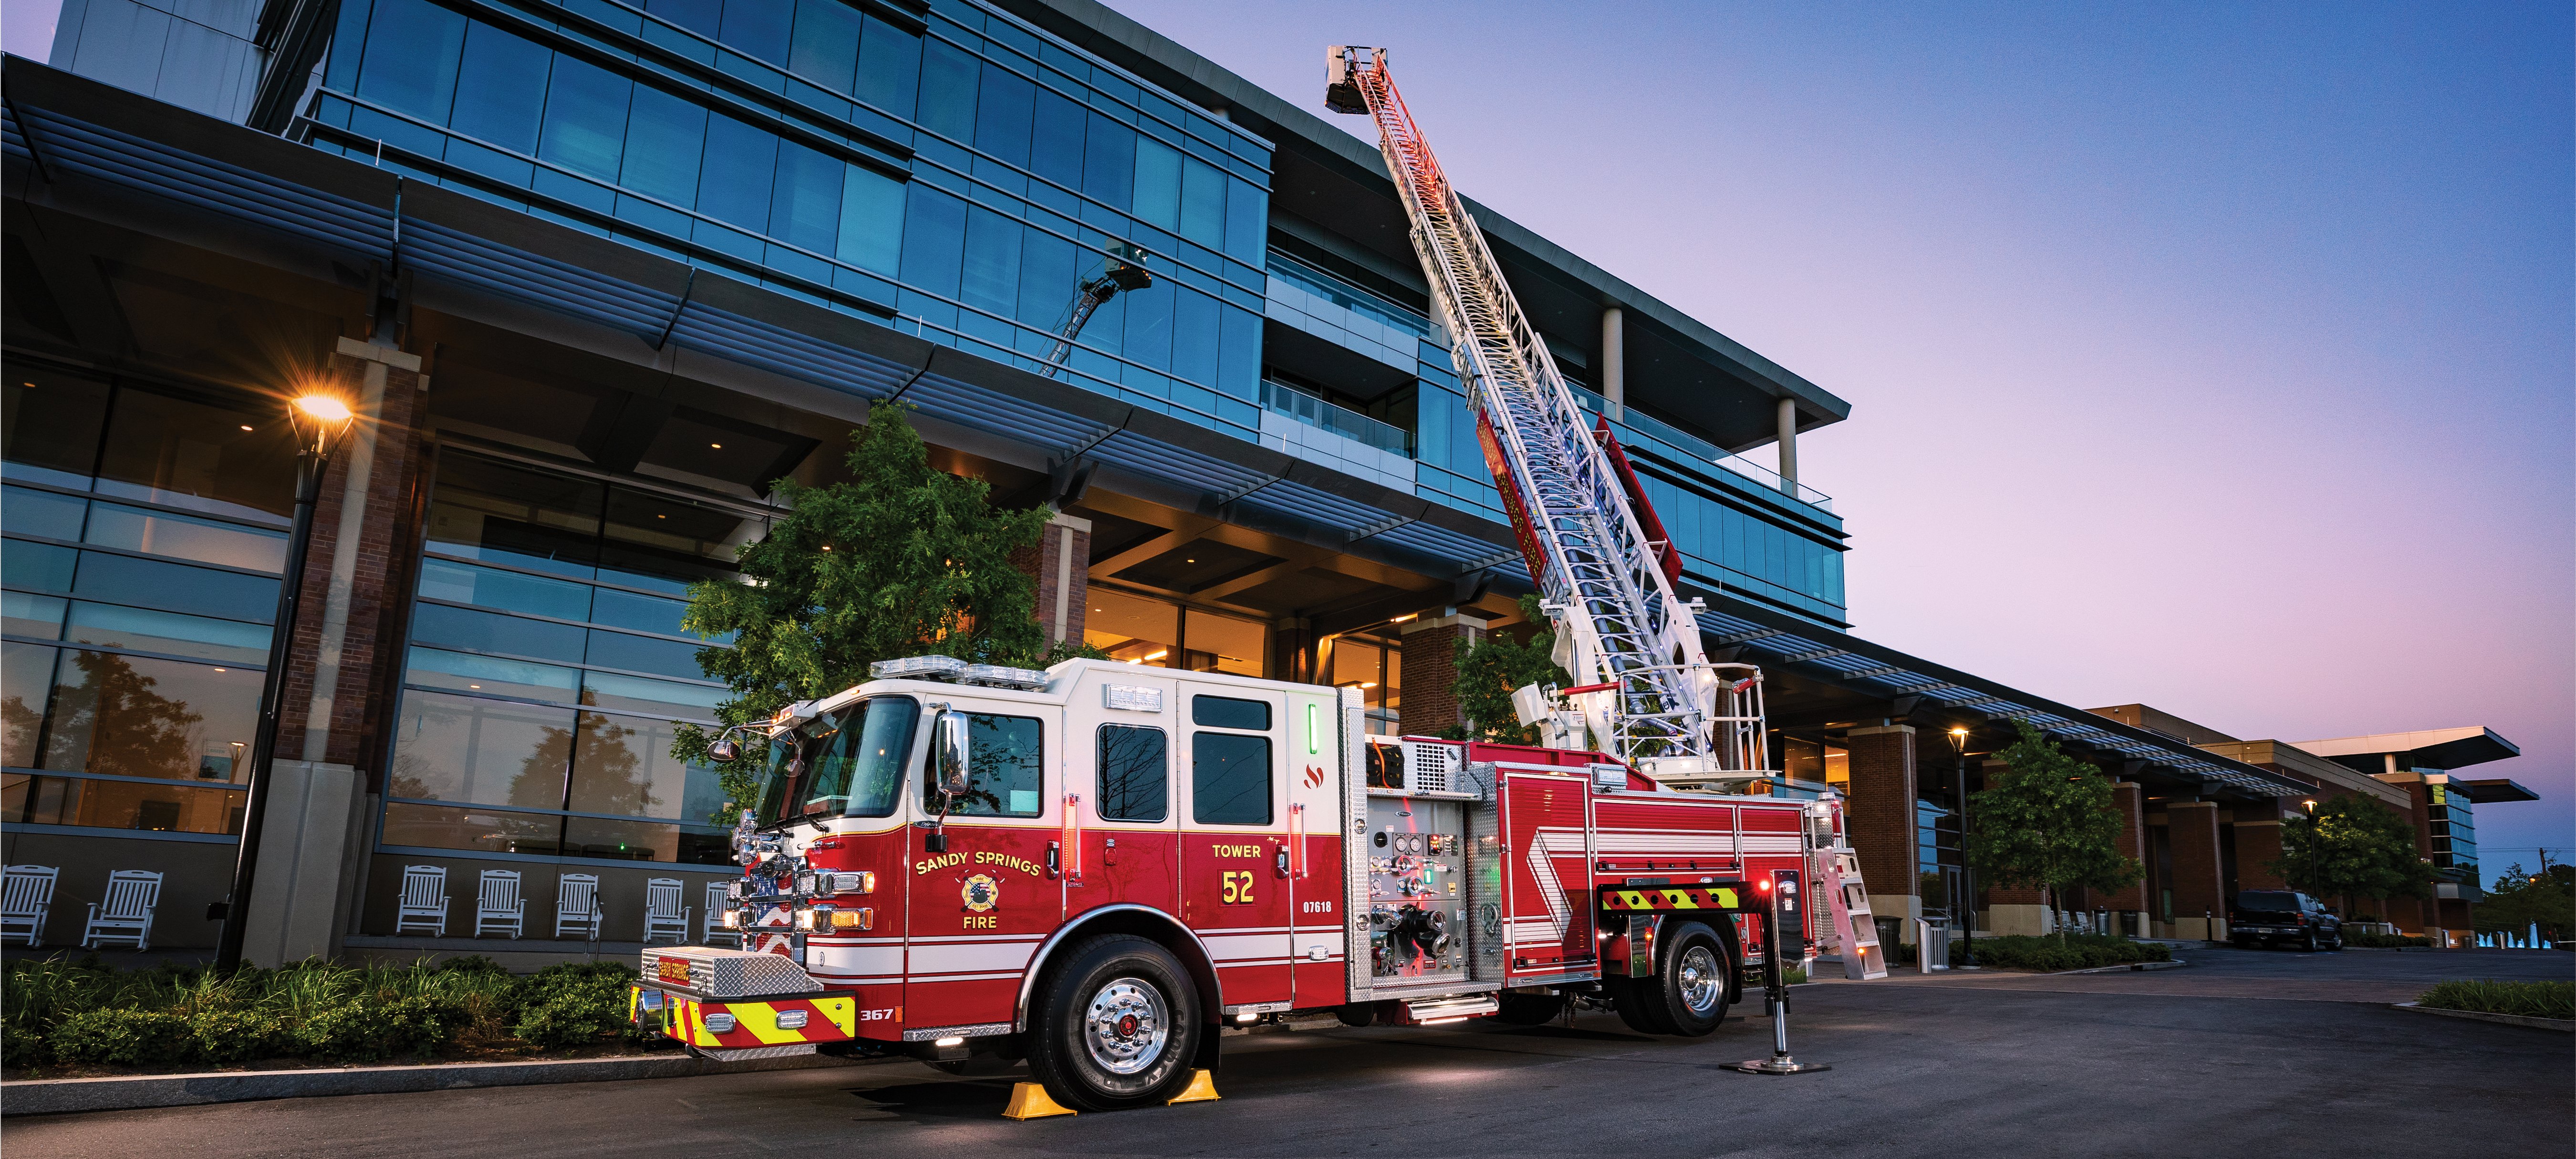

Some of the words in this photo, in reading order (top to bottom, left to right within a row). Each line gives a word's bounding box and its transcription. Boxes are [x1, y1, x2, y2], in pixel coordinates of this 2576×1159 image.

[1479, 419, 1497, 467] SANDY
[1496, 464, 1524, 533] SPRINGS
[1523, 532, 1540, 577] FIRE
[1212, 845, 1261, 858] TOWER
[915, 851, 968, 875] SANDY
[975, 851, 1041, 876] SPRINGS
[1222, 870, 1254, 904] 52
[1303, 901, 1331, 913] 07618
[963, 916, 997, 929] FIRE
[659, 961, 671, 977] SANDY
[860, 1008, 893, 1021] 367
